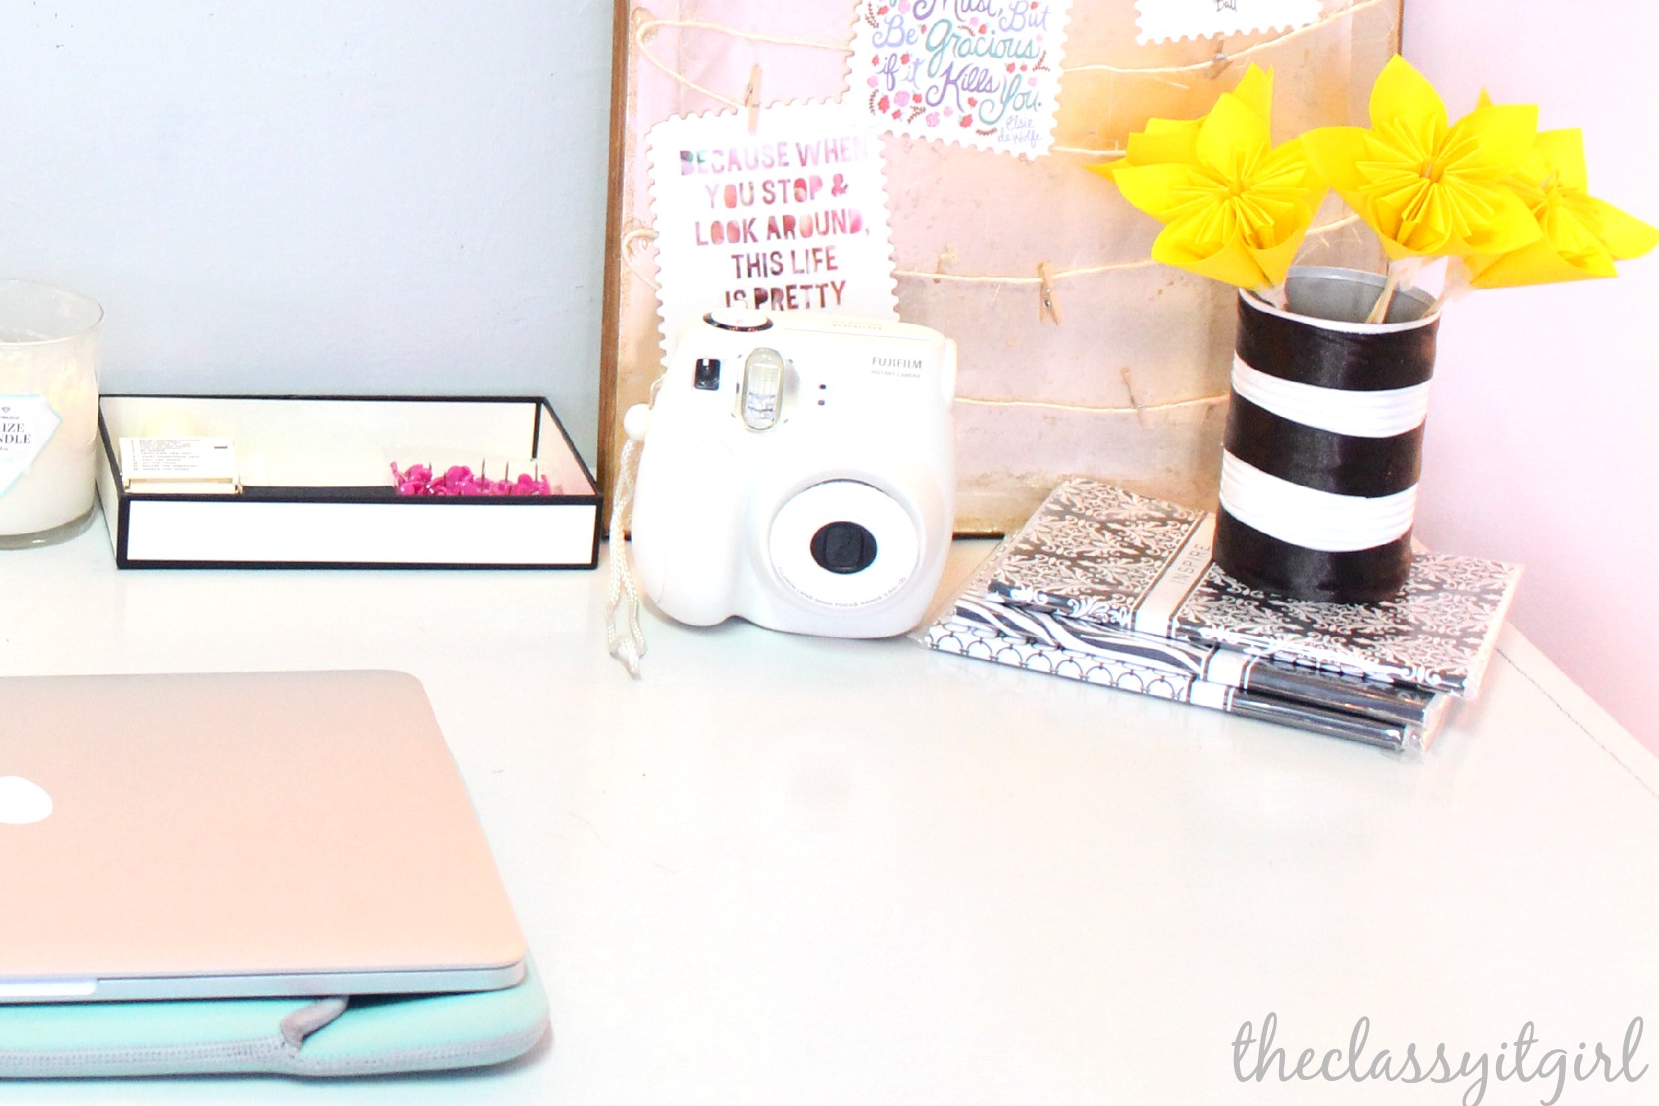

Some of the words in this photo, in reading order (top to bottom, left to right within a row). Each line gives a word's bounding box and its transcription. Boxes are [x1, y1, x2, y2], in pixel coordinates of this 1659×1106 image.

[872, 14, 919, 48] Be
[999, 0, 1049, 32] But
[877, 52, 899, 91] if
[900, 58, 924, 90] it
[925, 61, 1003, 113] Kills
[679, 142, 790, 176] BECAUSE
[796, 136, 869, 167] WHEN
[705, 181, 755, 209] YOU
[762, 174, 824, 205] STOP
[831, 173, 849, 197] &
[694, 218, 759, 246] LOOK
[766, 208, 870, 240] AROUND,
[731, 251, 784, 279] THIS
[790, 246, 839, 275] LIFE
[724, 290, 749, 309] IS
[754, 280, 846, 311] PRETTY
[872, 357, 922, 369] FUJIFILM
[1170, 543, 1211, 585] INSPIRE
